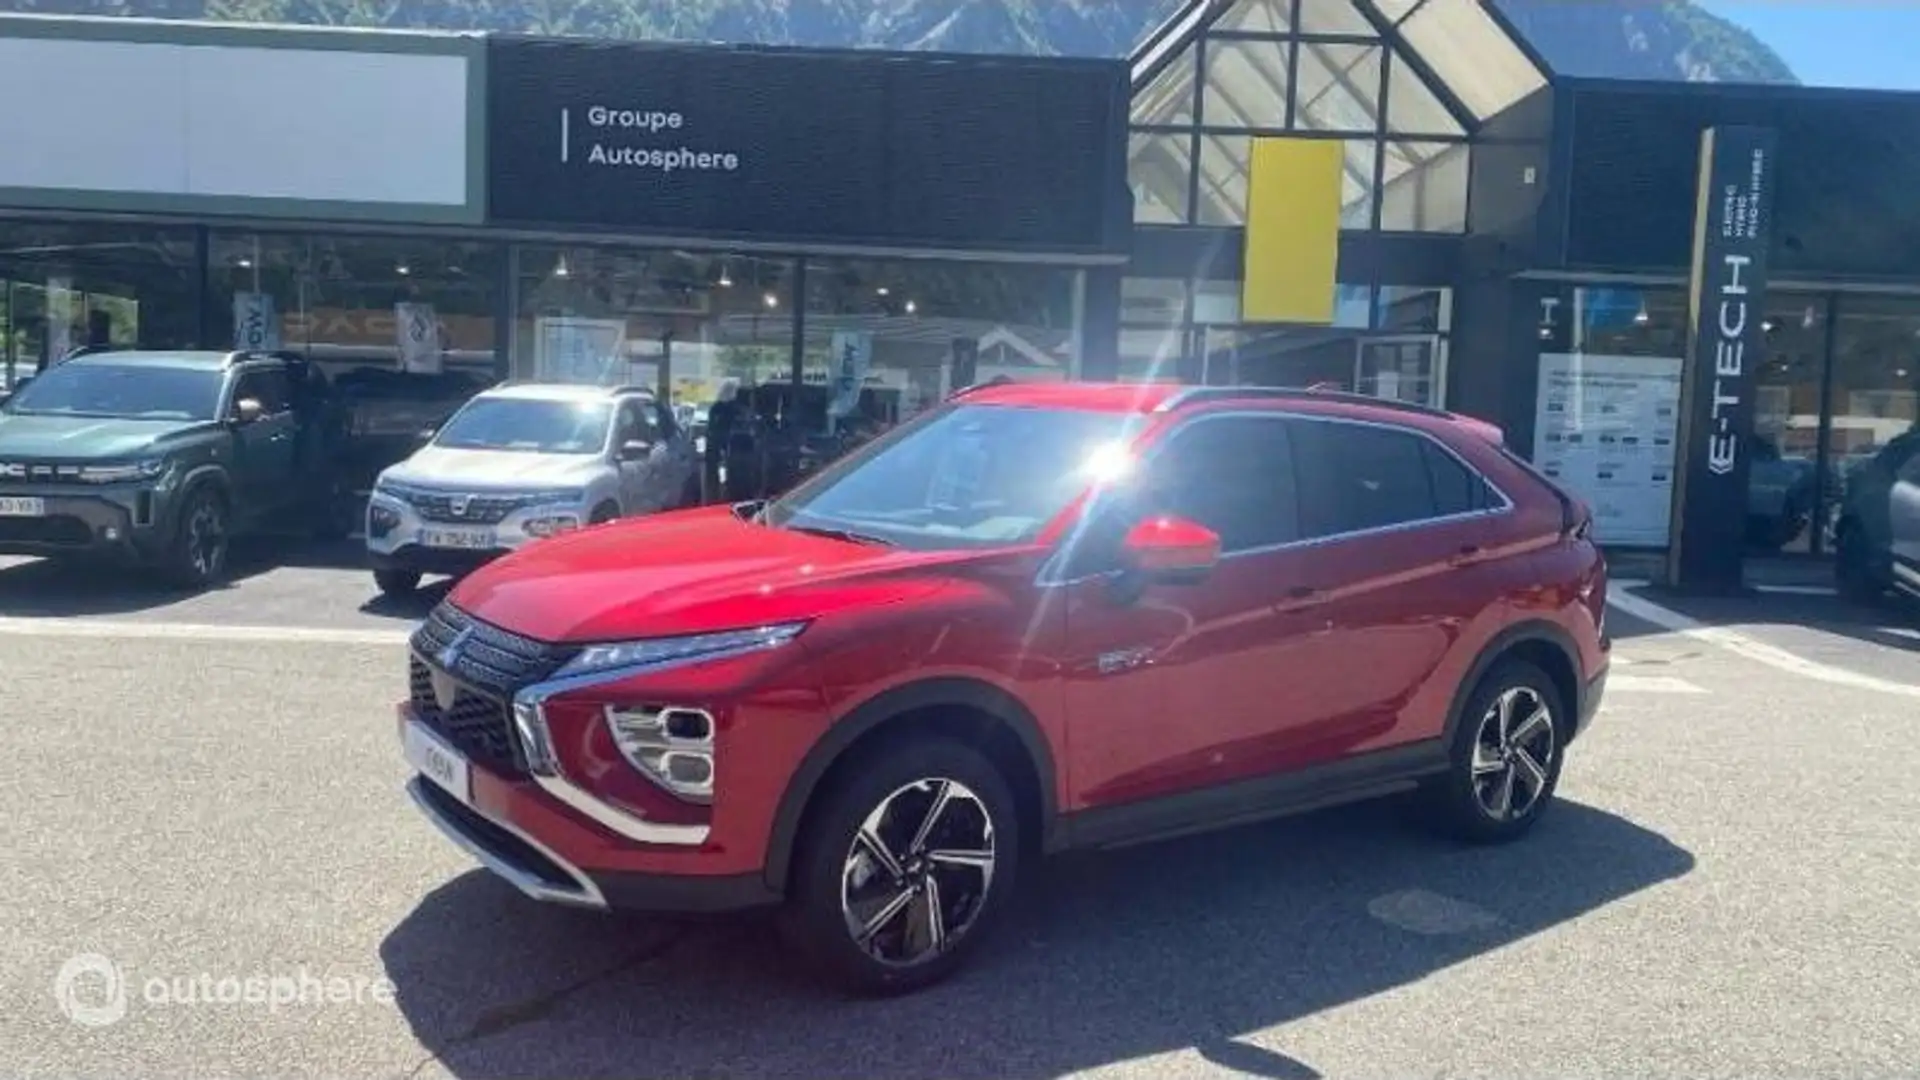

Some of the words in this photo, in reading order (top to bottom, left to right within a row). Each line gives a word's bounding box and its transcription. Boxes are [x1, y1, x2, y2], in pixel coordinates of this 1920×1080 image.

[588, 106, 683, 133] Groupe
[588, 144, 739, 172] Autosphere
[1709, 254, 1751, 475] E-TECH
